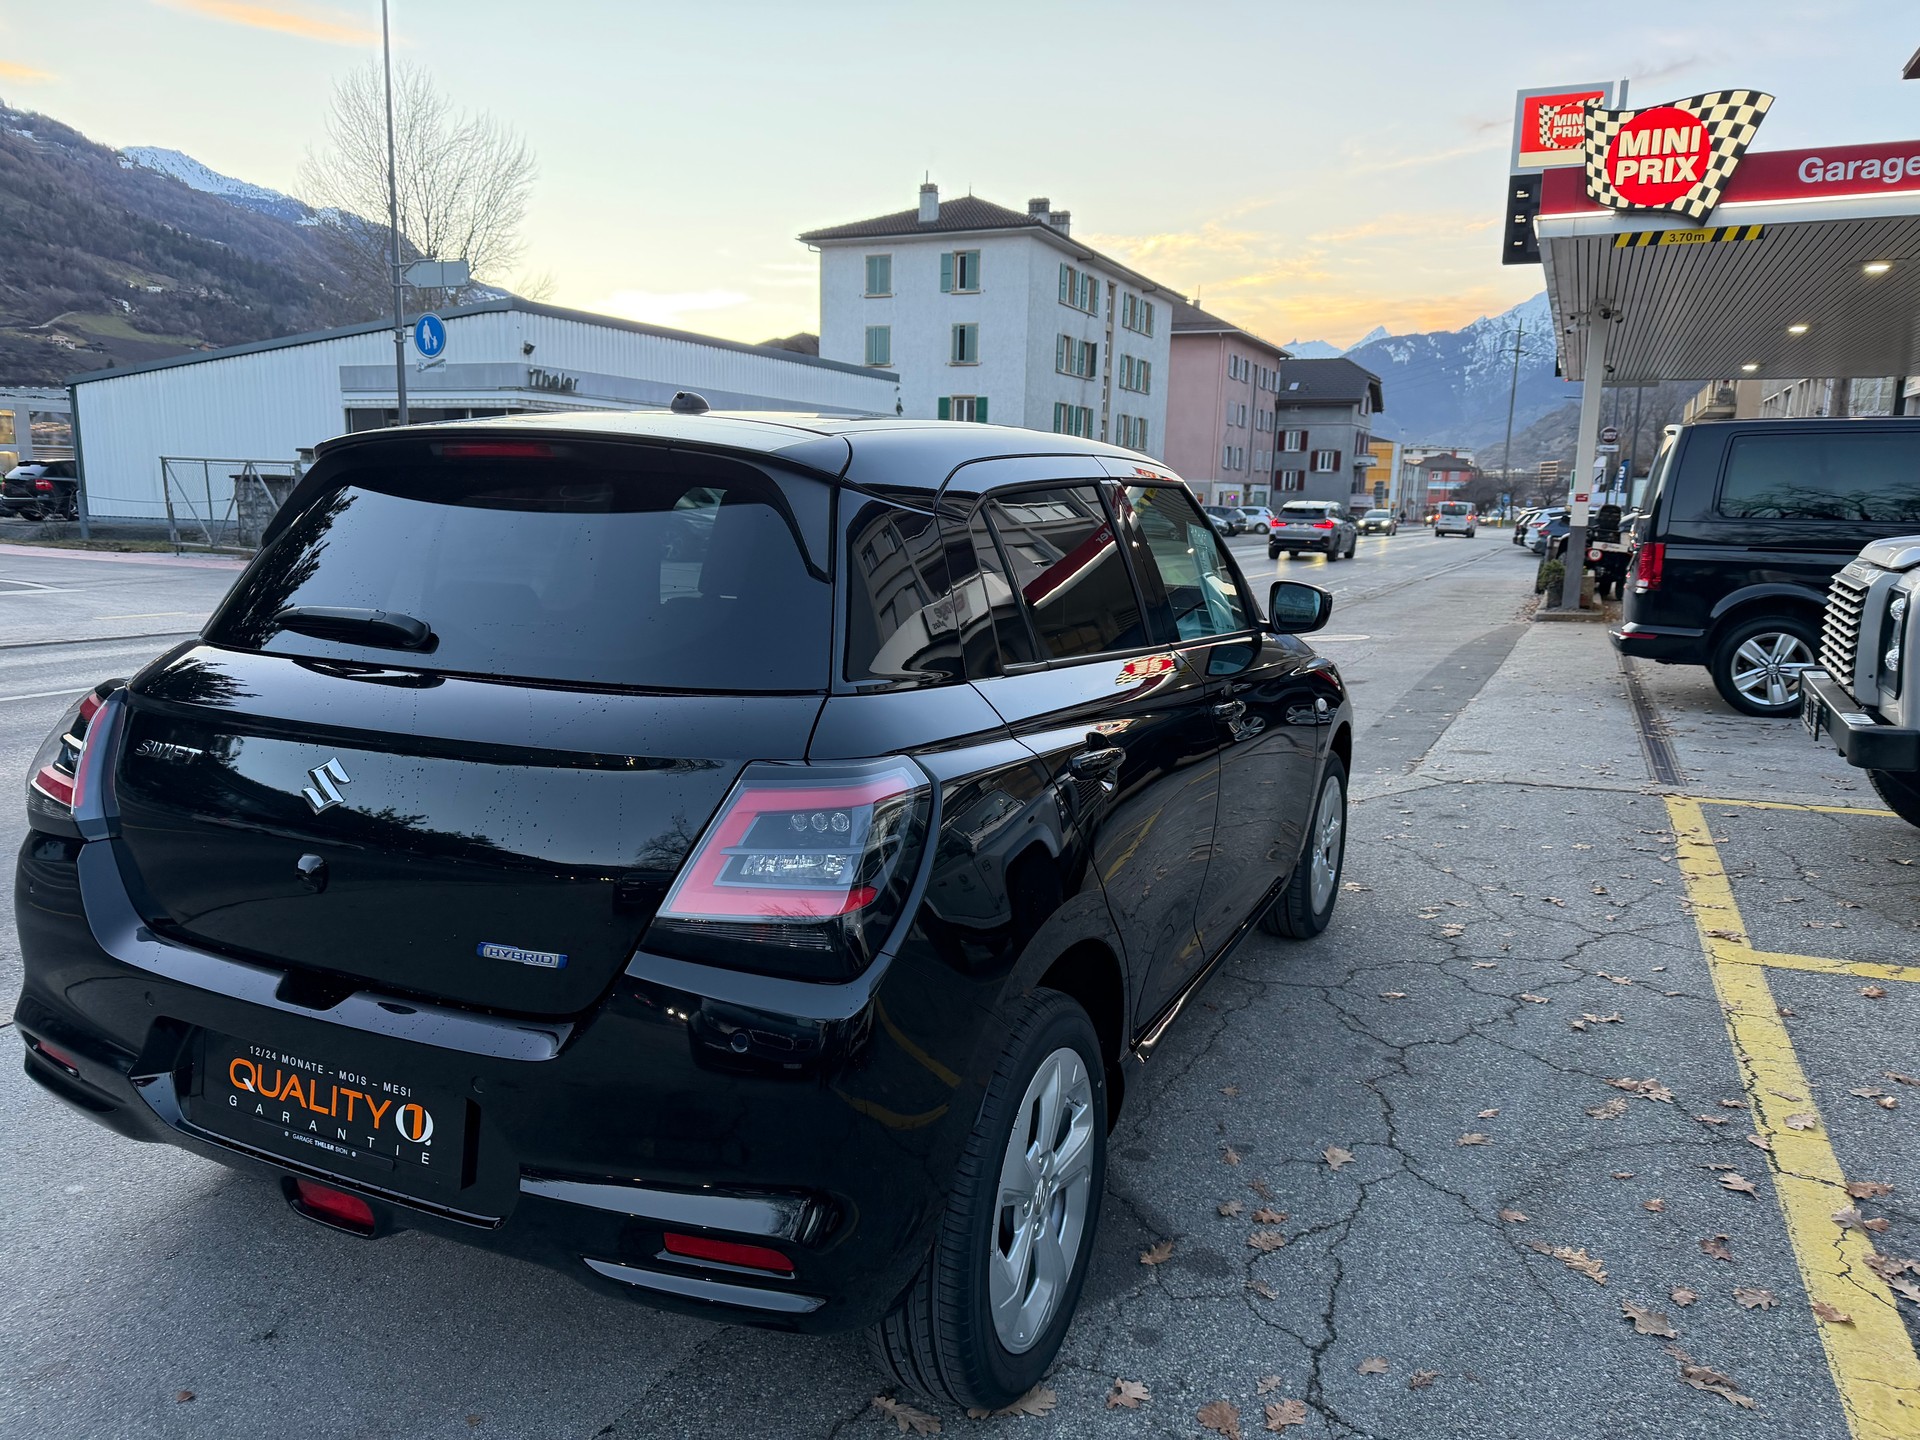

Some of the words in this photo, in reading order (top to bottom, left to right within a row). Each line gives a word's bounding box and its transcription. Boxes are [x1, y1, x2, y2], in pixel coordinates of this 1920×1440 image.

[1553, 112, 1584, 127] MIN
[1618, 125, 1702, 158] MINI
[1615, 155, 1700, 186] PRIX
[1798, 155, 1920, 184] Garage
[134, 739, 203, 764] SWIFT
[489, 948, 553, 964] HYBRID
[249, 1045, 277, 1061] 12/24
[281, 1053, 324, 1075] MONATE
[338, 1070, 367, 1086] MOIS
[382, 1081, 411, 1098] MESI
[229, 1057, 392, 1130] QUALITY
[228, 1094, 430, 1165] GARANTIE
[292, 1133, 313, 1145] GARAGE
[314, 1139, 335, 1151] THELER
[335, 1146, 348, 1155] SION
